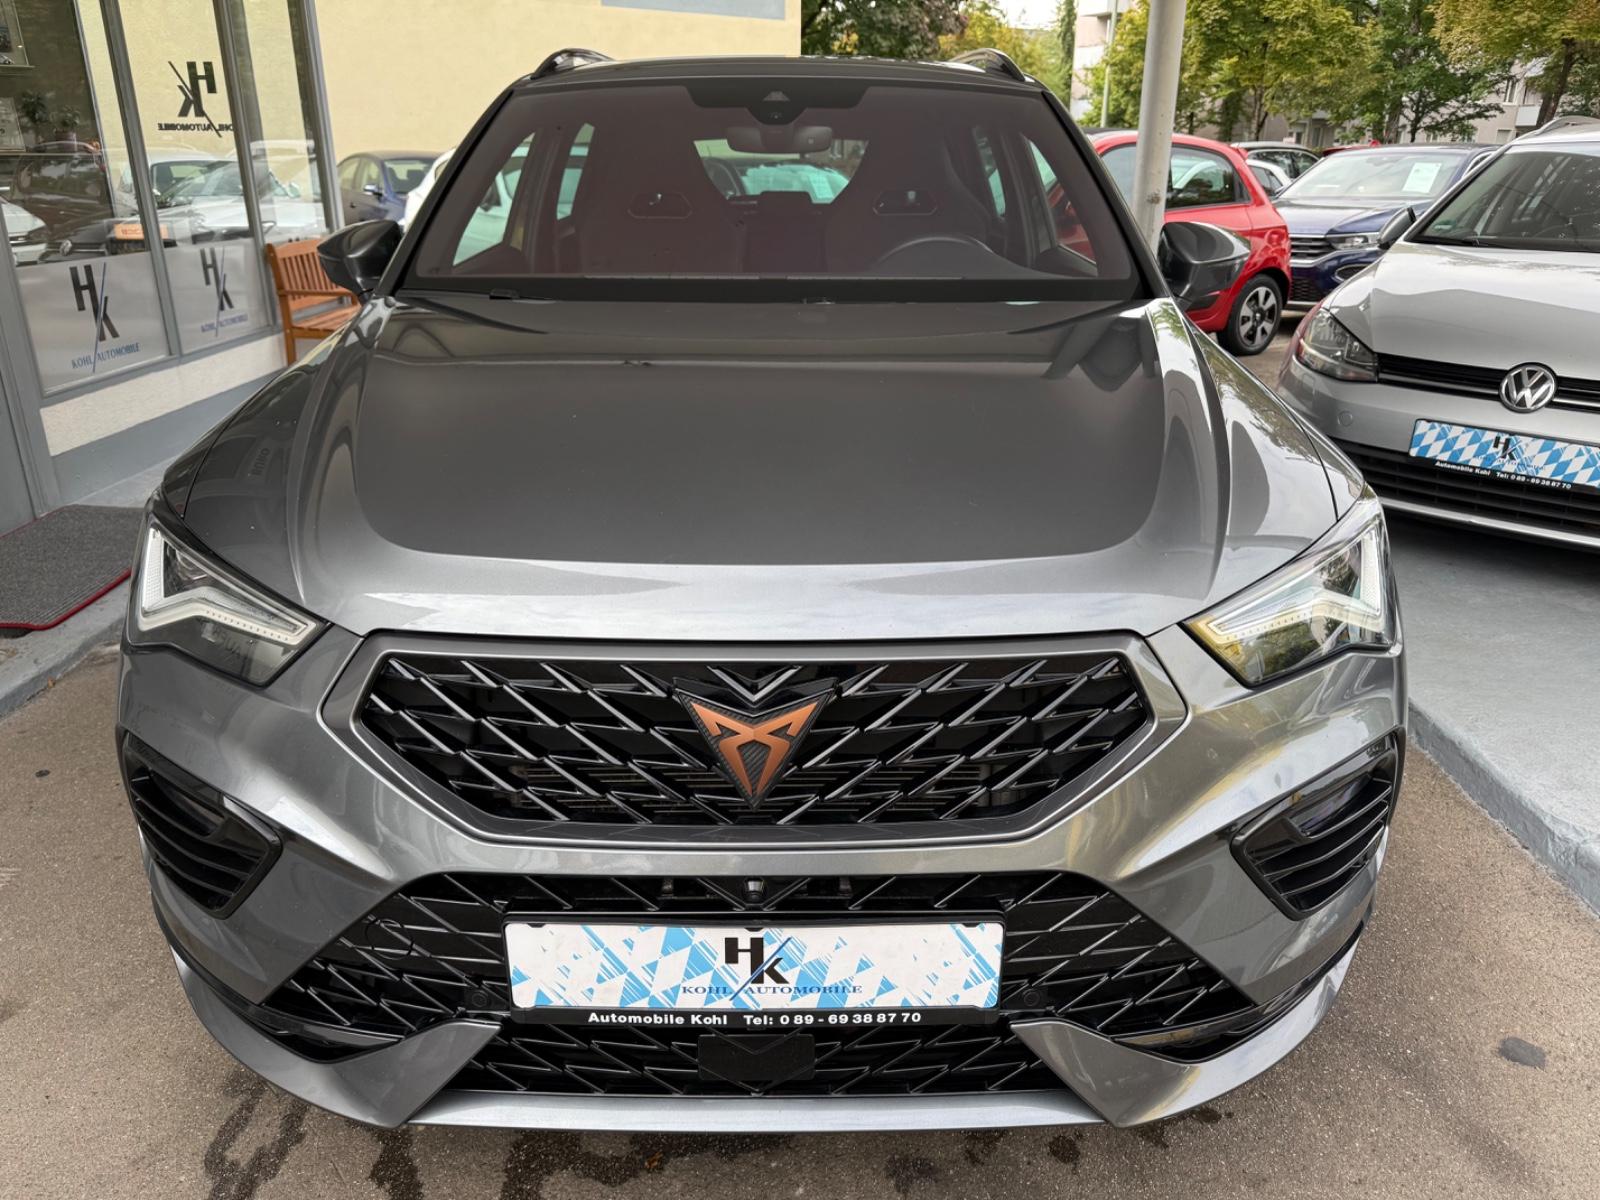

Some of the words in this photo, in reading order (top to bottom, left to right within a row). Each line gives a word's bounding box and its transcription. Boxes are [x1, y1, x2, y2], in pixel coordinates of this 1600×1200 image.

[71, 354, 94, 369] KOHL
[1435, 460, 1473, 473] Automobile
[1475, 468, 1491, 477] Kohl
[682, 986, 734, 995] KOHL
[744, 985, 863, 995] AUTOMOBILE
[588, 1012, 685, 1025] Automobile
[691, 1014, 728, 1025] Kohl
[743, 1015, 773, 1025] Tel:
[828, 1014, 849, 1025] 69
[852, 1013, 873, 1024] 38
[877, 1012, 897, 1023] 87
[901, 1012, 922, 1023] 70
